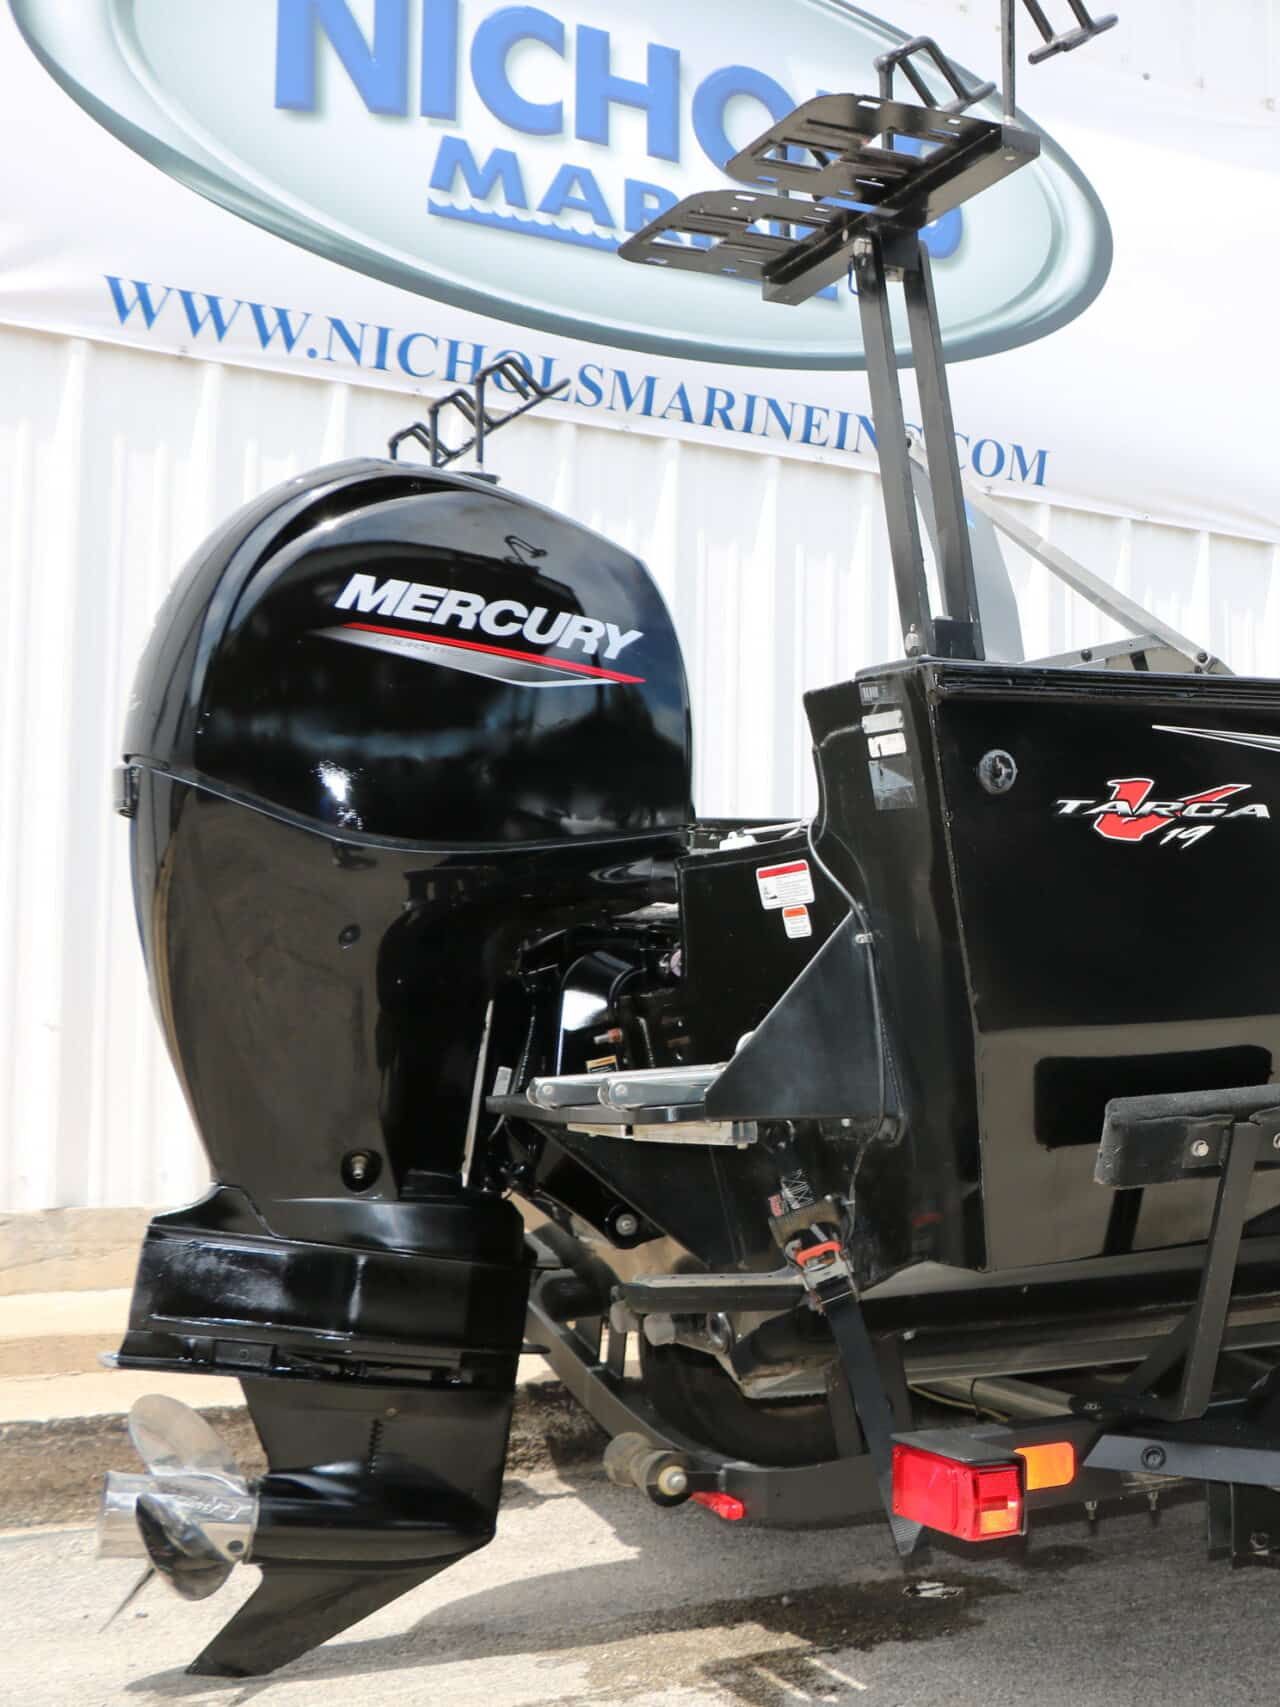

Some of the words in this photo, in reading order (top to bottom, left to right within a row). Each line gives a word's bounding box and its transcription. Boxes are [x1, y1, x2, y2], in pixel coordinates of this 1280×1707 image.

[274, 0, 963, 260] NICHO
[103, 274, 1051, 487] WWW.NICHOLSMARINEINOM
[334, 573, 644, 660] MERCURY
[1056, 799, 1271, 818] TARGA
[1159, 825, 1216, 849] 19
